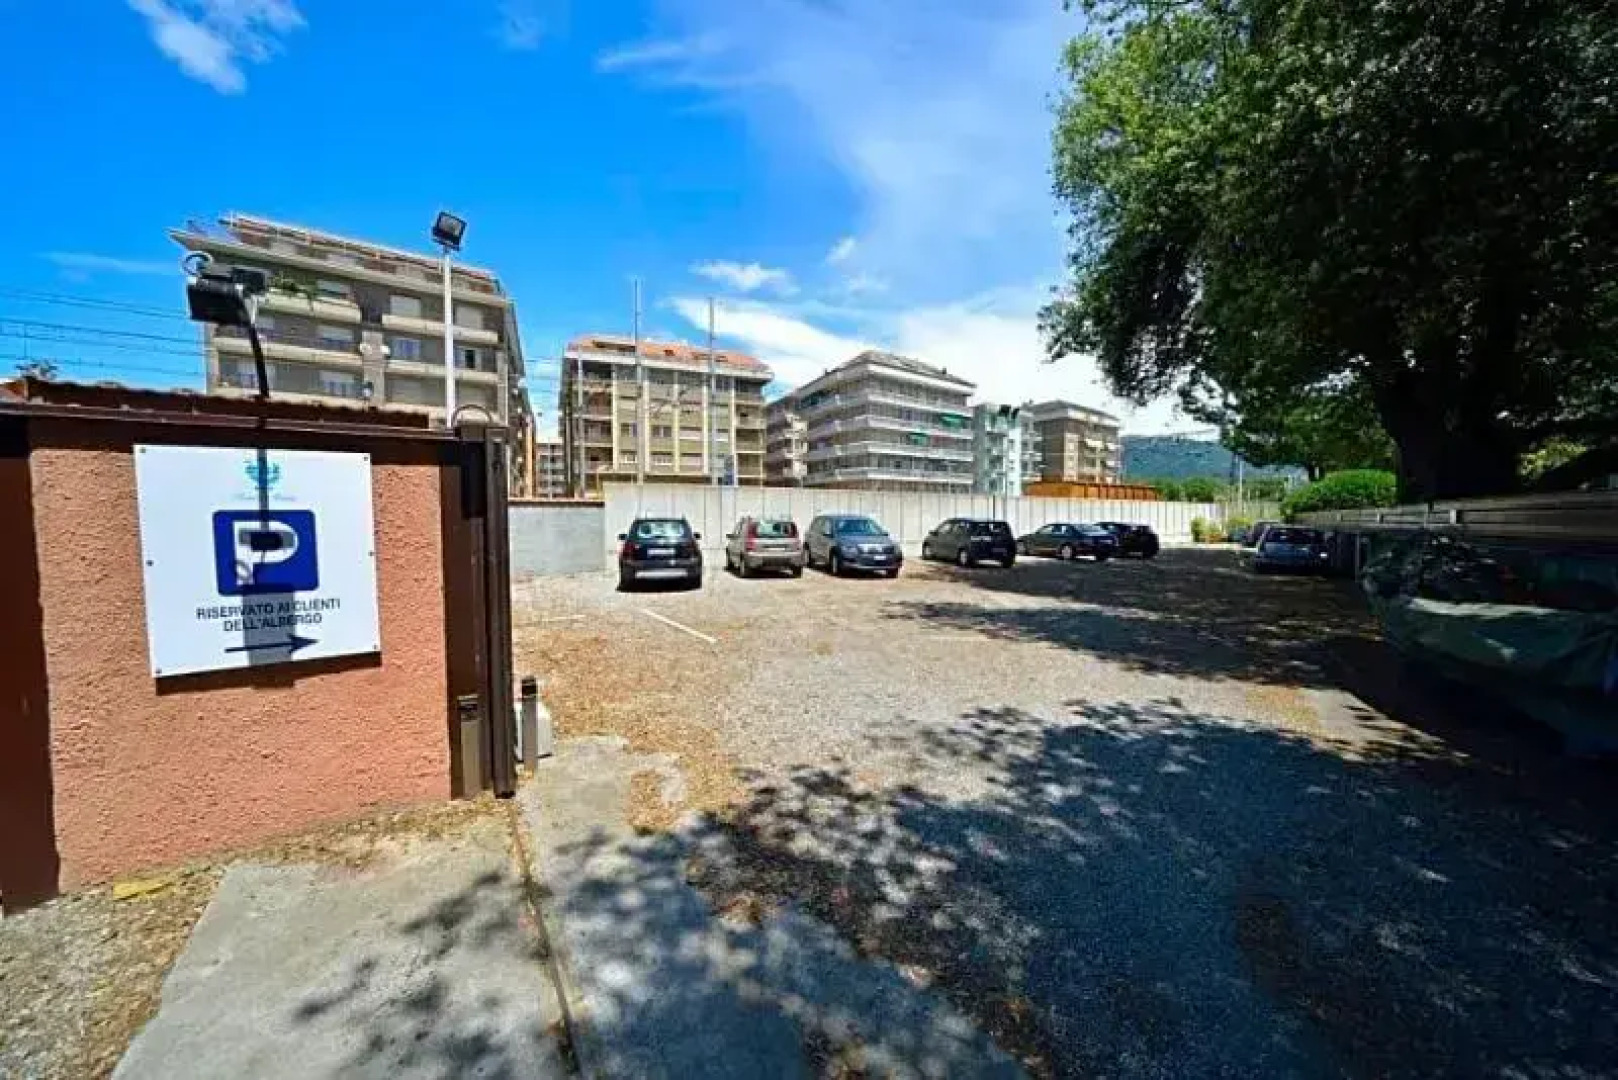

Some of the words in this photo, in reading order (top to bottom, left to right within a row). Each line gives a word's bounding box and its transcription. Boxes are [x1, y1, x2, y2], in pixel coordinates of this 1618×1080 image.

[233, 521, 299, 585] P
[195, 603, 274, 620] RISERVATO
[278, 602, 291, 614] AI
[293, 598, 341, 612] CLIENTI
[223, 612, 322, 632] DELL'ALBERGO
